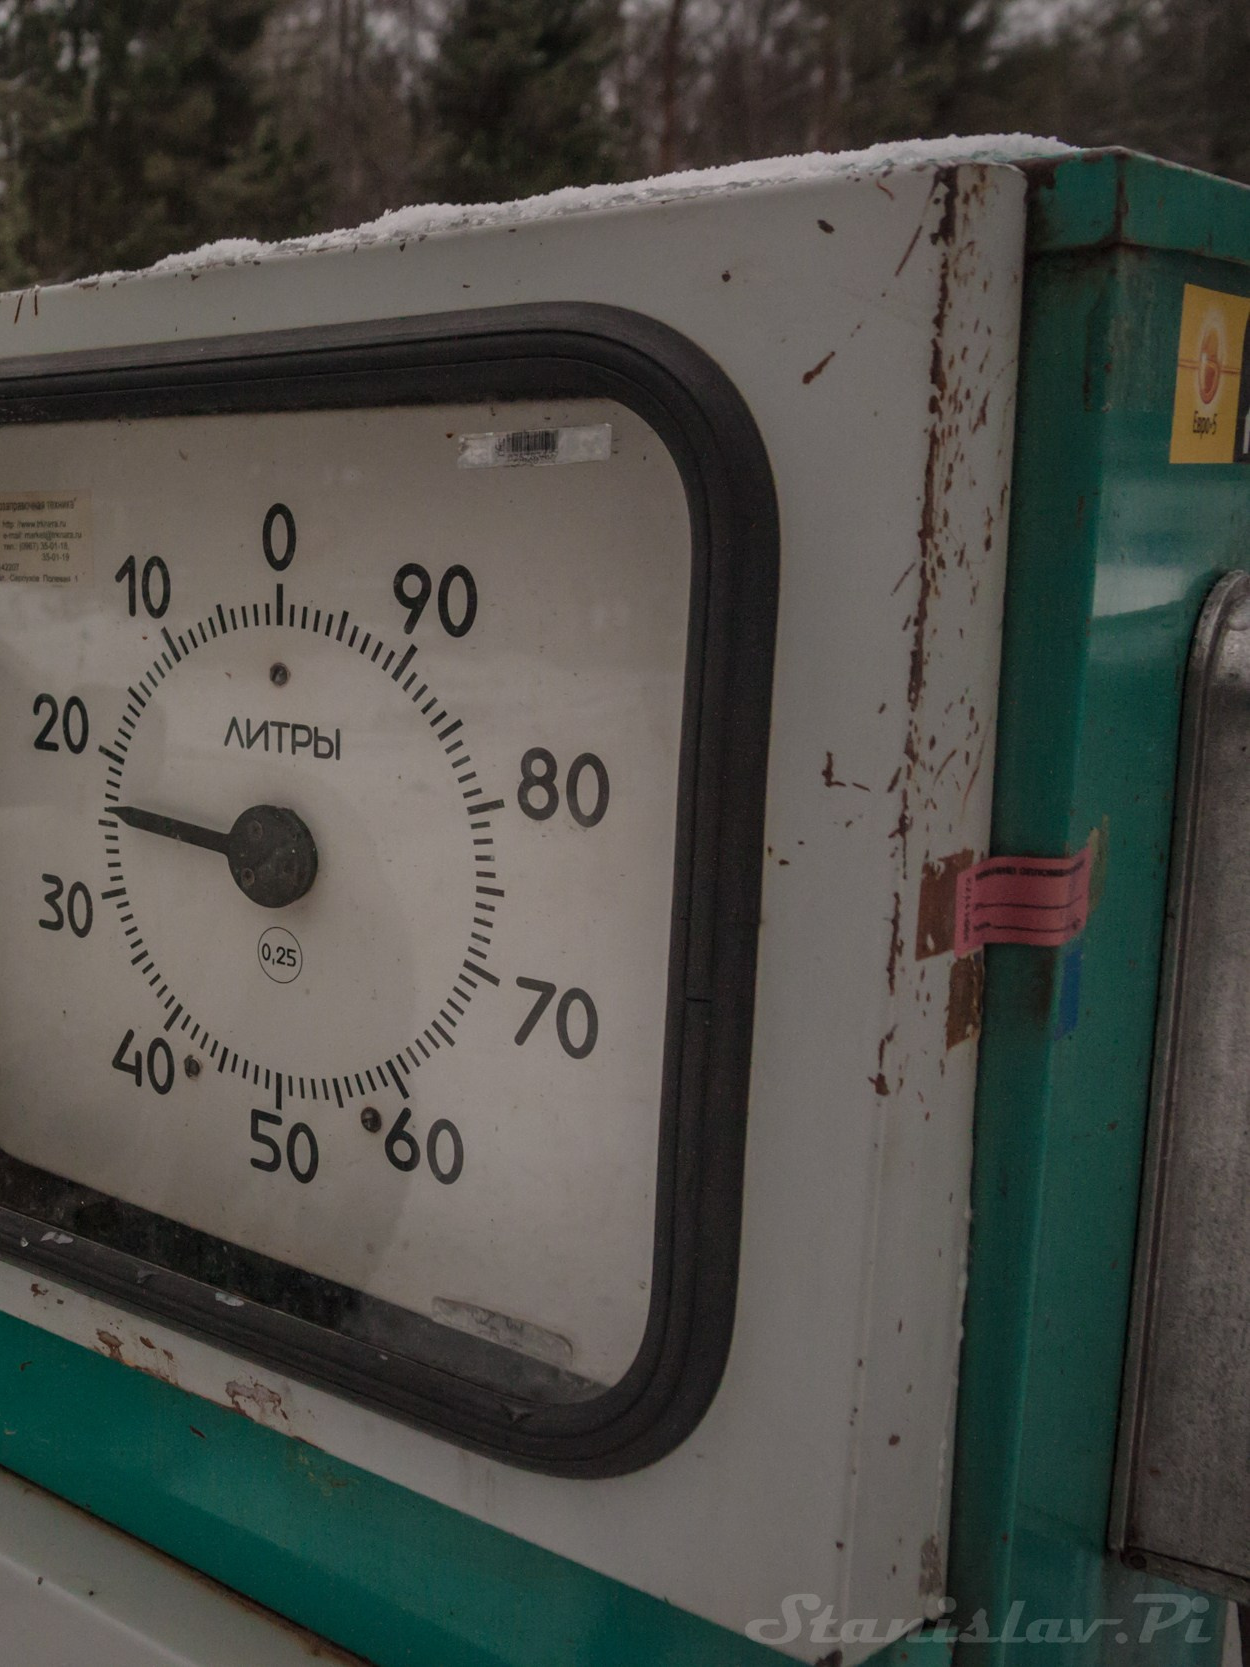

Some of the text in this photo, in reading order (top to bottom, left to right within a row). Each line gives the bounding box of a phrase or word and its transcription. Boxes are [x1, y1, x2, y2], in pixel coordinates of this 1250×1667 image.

[263, 503, 296, 571] 0
[115, 555, 170, 618] 10
[394, 563, 477, 637] 90
[33, 694, 88, 754] 20
[224, 717, 340, 760] ЛИТРЫ
[518, 747, 609, 827] 80
[39, 874, 93, 938] 30
[261, 943, 297, 967] 0,25
[515, 977, 598, 1059] 70
[112, 1029, 174, 1095] 40
[250, 1109, 319, 1184] 50
[384, 1107, 463, 1184] 60
